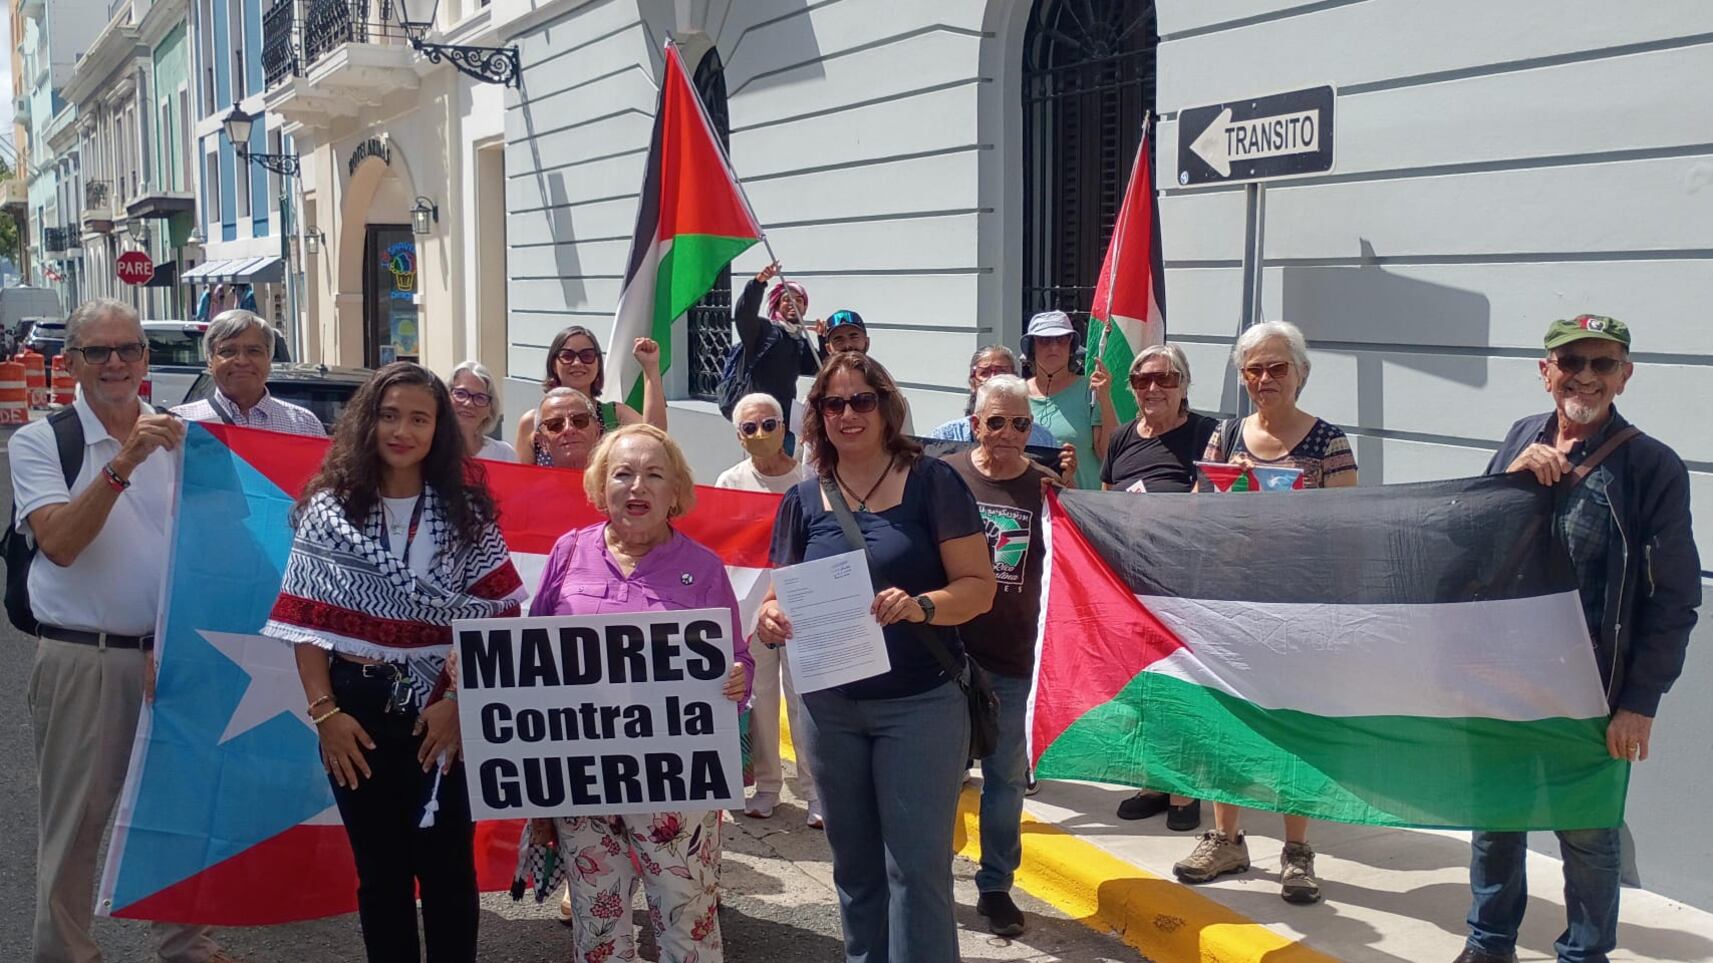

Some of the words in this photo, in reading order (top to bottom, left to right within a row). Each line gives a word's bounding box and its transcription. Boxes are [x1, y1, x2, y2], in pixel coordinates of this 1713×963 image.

[1224, 115, 1314, 156] TRANSITO
[117, 261, 152, 276] PARE
[459, 620, 726, 689] MADRES
[481, 702, 653, 744] Contra
[665, 696, 715, 736] la
[479, 750, 731, 809] GUERRA
